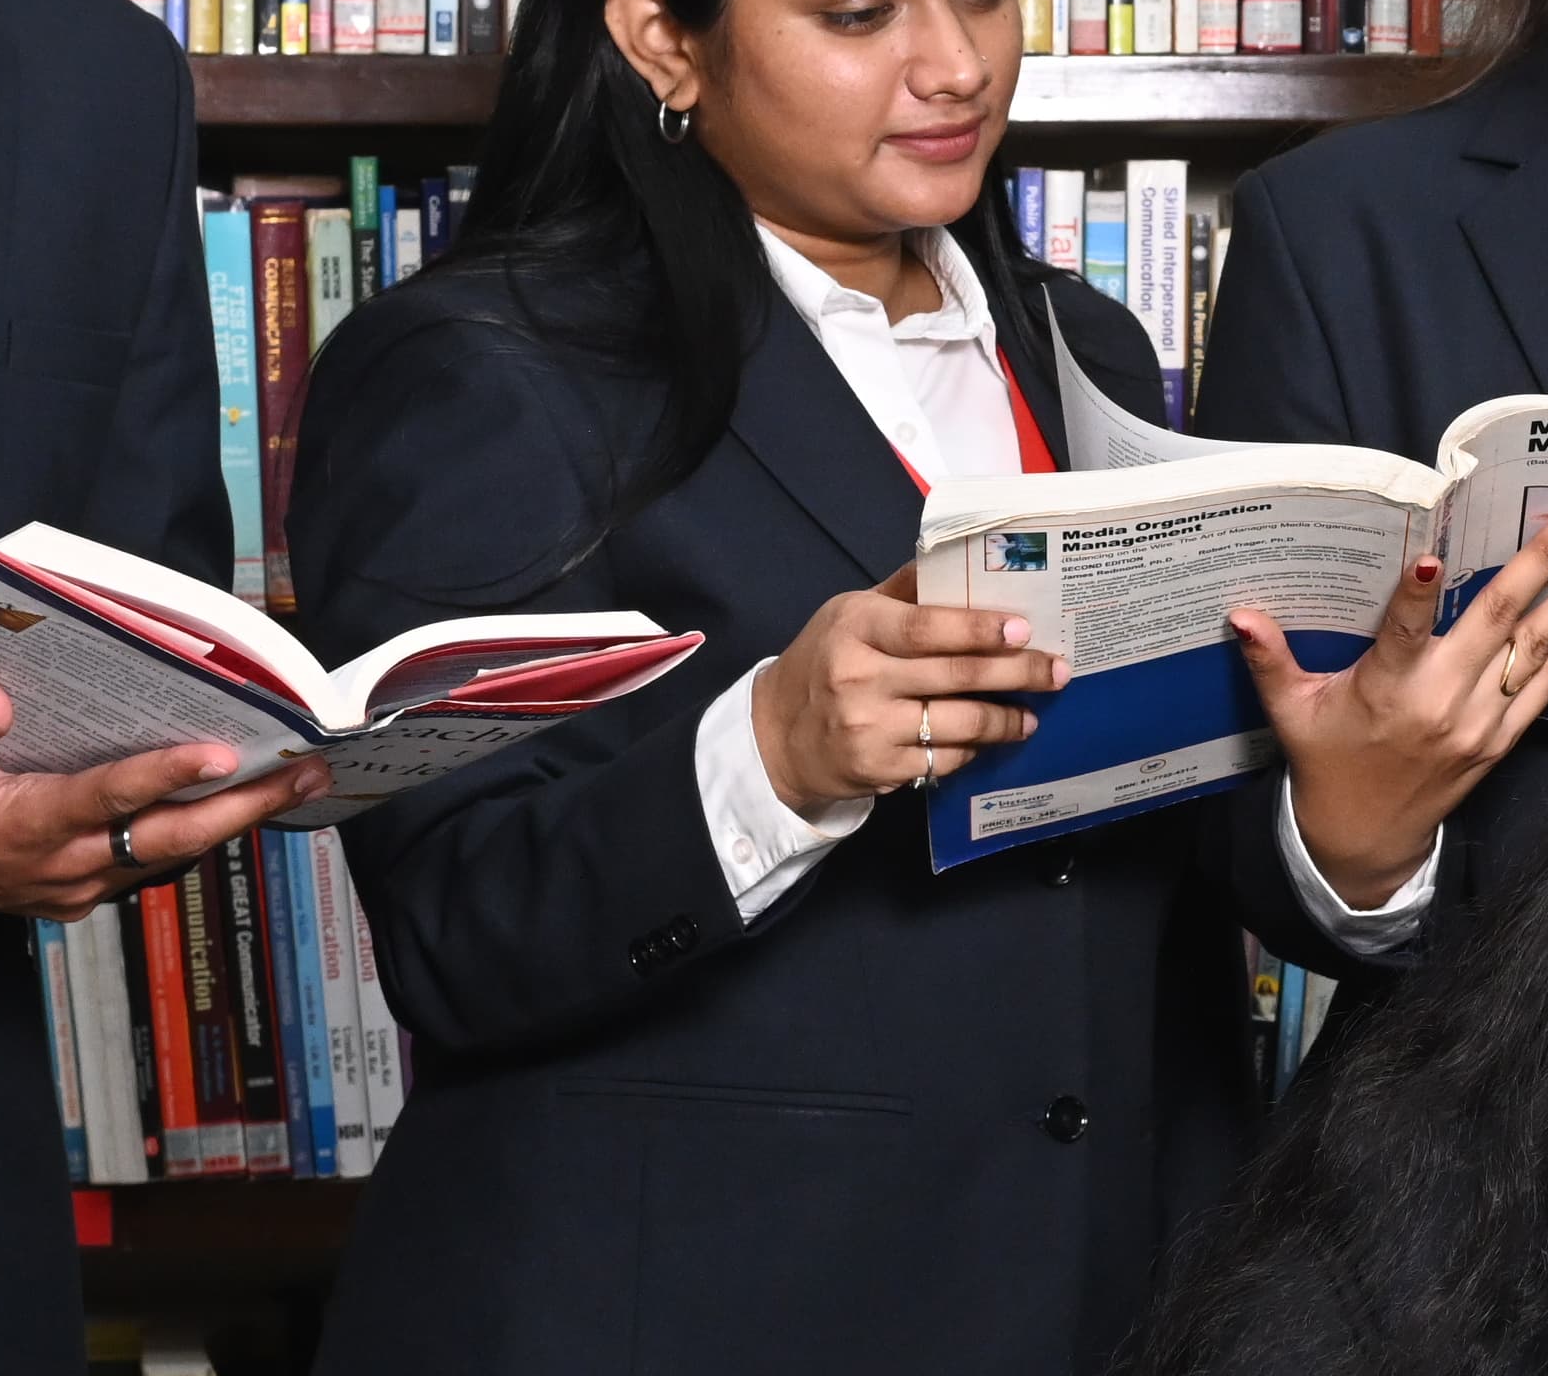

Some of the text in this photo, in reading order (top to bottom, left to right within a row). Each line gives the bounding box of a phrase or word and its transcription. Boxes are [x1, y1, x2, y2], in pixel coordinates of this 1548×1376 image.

[1062, 502, 1272, 541] Media Organization
[1062, 524, 1202, 553] Management
[1061, 556, 1143, 573] SECOND EDITION
[314, 831, 341, 980] Communication
